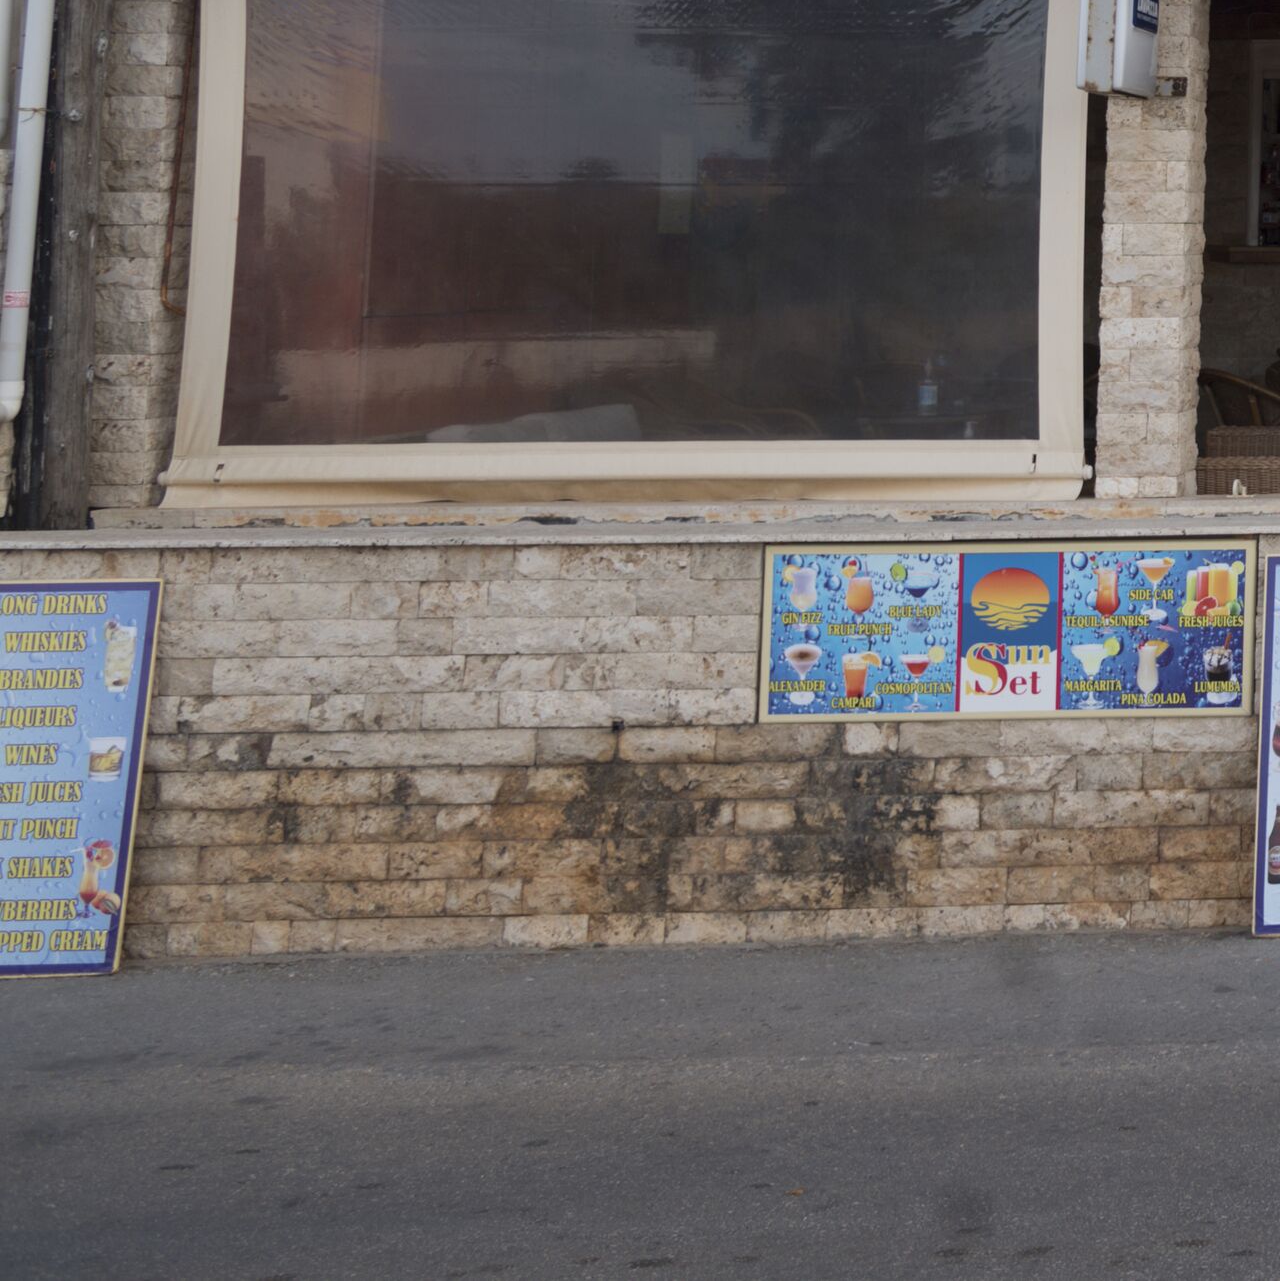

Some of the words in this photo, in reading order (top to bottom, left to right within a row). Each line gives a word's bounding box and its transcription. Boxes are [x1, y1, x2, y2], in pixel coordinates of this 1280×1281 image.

[1129, 589, 1152, 601] SIDE
[1155, 589, 1174, 600] CAR
[0, 595, 38, 615] ONG
[42, 594, 108, 615] DRINKS
[889, 606, 915, 617] BLUE
[916, 605, 943, 617] LADY
[782, 613, 800, 624] GIN
[801, 612, 824, 623] FIZZ
[1066, 616, 1107, 628] TEQUILA
[1109, 615, 1150, 626] SUNRISE
[1179, 616, 1209, 627] FRESH
[1211, 615, 1244, 627] JUICES
[828, 624, 858, 636] FRUIT
[859, 624, 893, 635] PUNCH
[5, 631, 87, 653] WHISKIES
[965, 642, 1051, 695] Sun
[975, 643, 1041, 695] Set
[0, 668, 84, 690] BRANDIES
[1064, 680, 1122, 691] MARGARITA
[769, 681, 826, 692] ALEXANDER
[875, 682, 952, 694] COSMOPOLITAN
[1194, 681, 1241, 693] LUMUMBA
[831, 697, 876, 709] CAMPARI
[1121, 694, 1144, 704] PINA
[1147, 693, 1187, 704] COLADA
[5, 743, 58, 766] WINES
[27, 781, 82, 805] JUICES
[20, 817, 79, 840] PUNCH
[8, 856, 74, 879] SHAKES
[0, 899, 78, 921] BERRIES
[50, 930, 109, 951] CREAM
